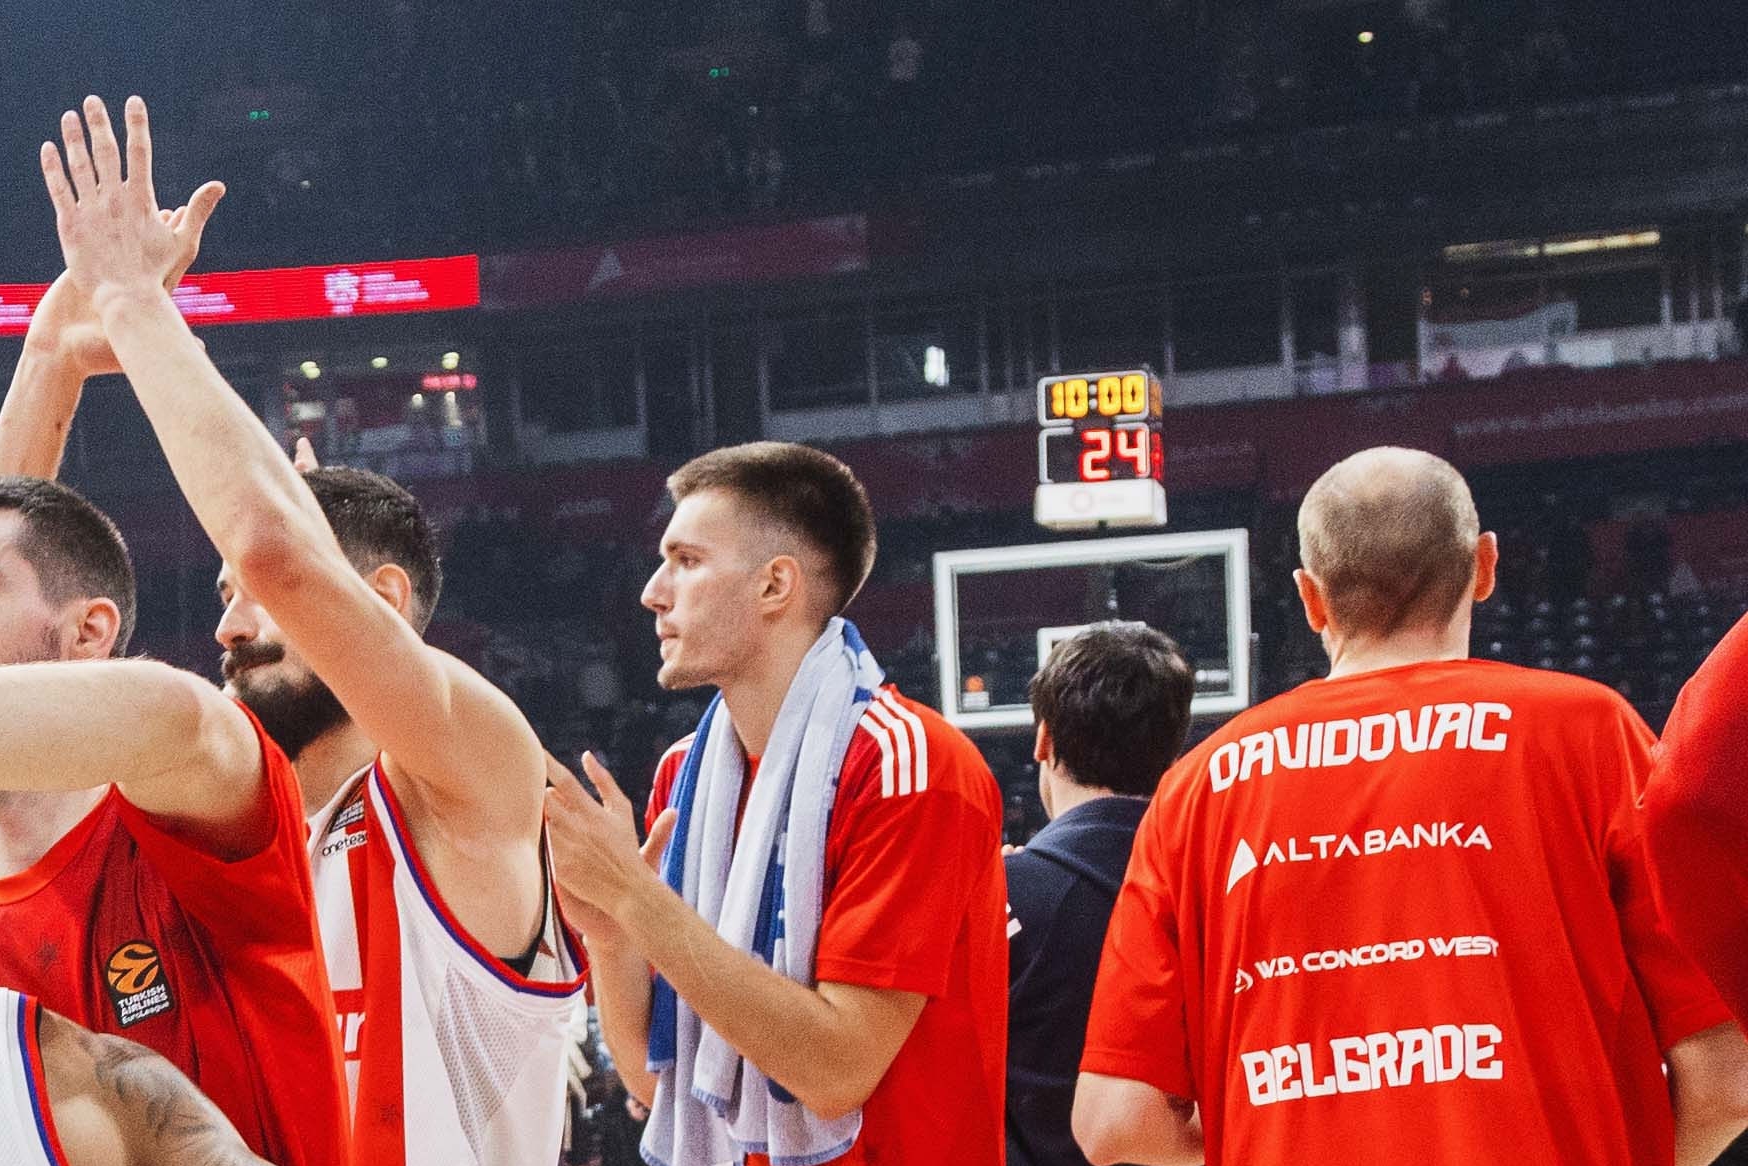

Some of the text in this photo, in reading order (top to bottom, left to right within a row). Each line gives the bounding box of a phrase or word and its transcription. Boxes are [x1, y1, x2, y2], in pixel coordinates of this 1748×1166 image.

[1051, 374, 1145, 418] 10:00
[1080, 429, 1150, 481] 24
[1209, 702, 1512, 793] DAVIDOVAC
[1255, 935, 1499, 979] W.D. CONCORD WEST
[118, 984, 166, 1009] TURKISH
[121, 992, 169, 1017] AIRLINES
[1240, 1024, 1504, 1106] BELGRADE
